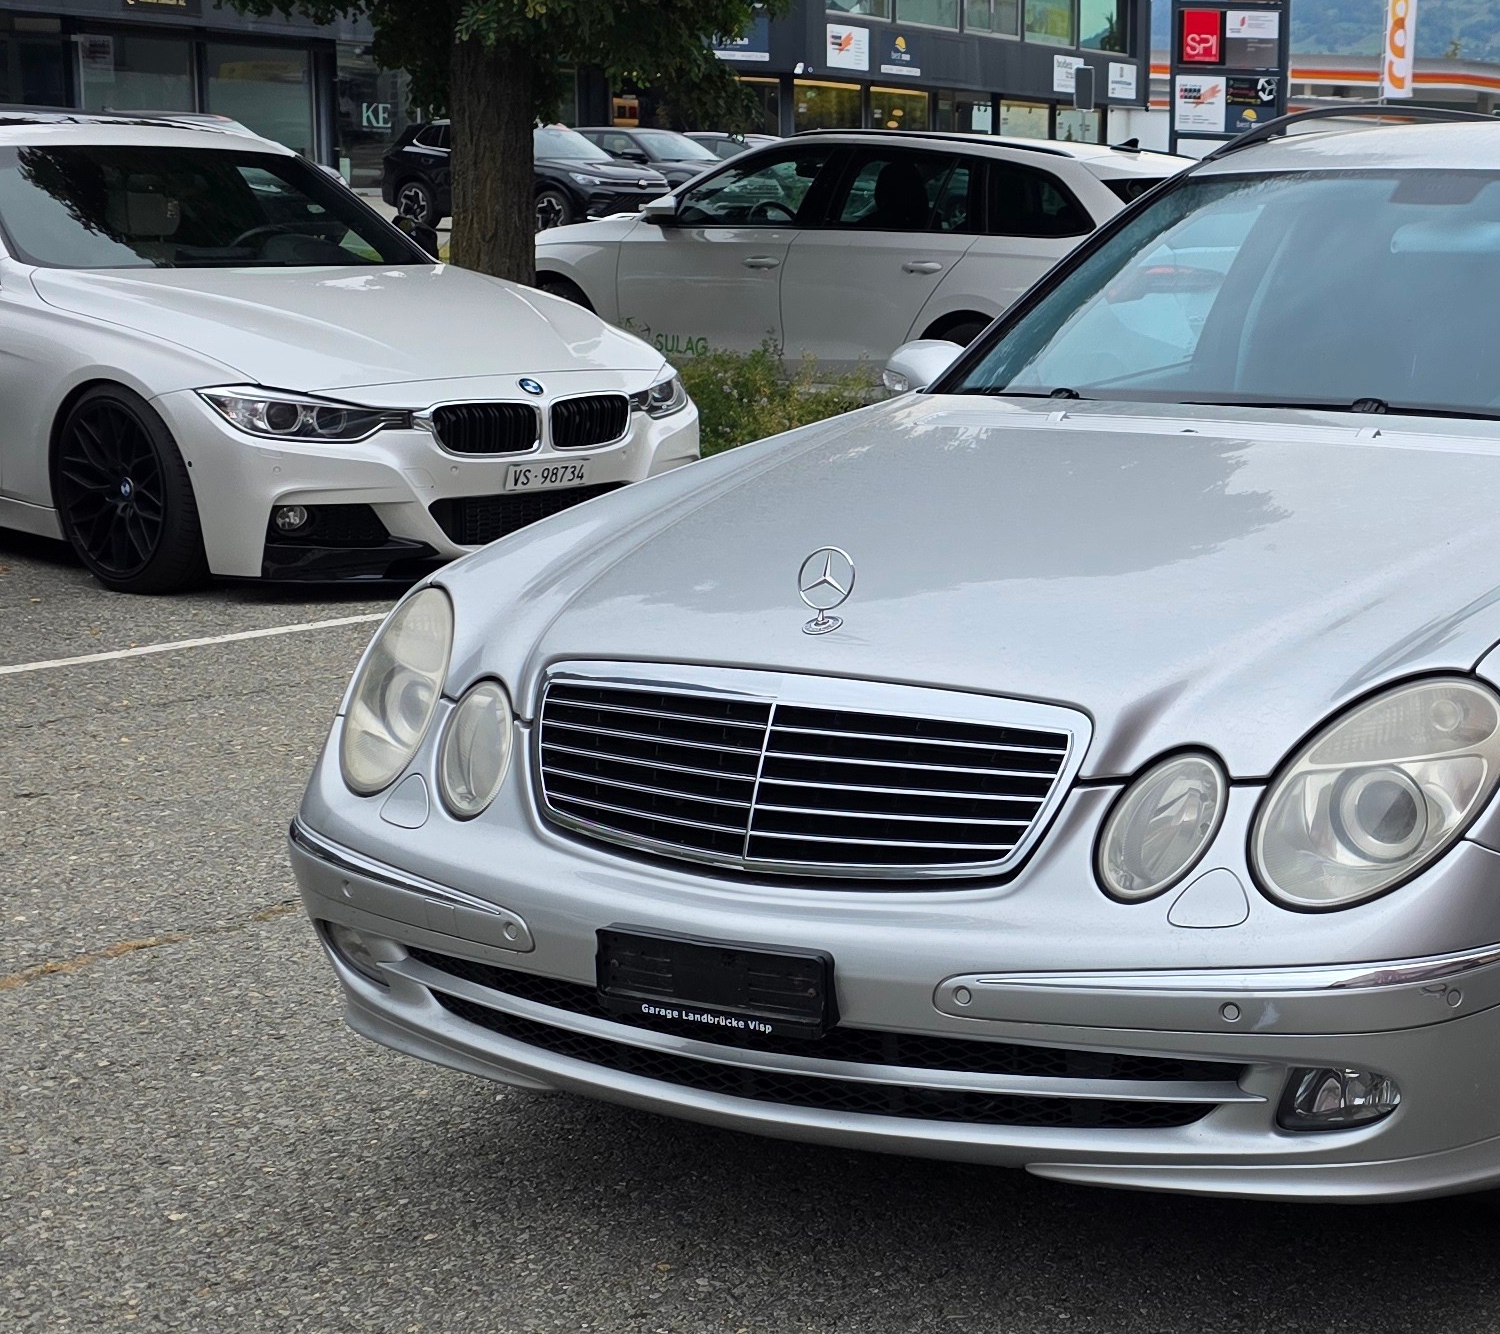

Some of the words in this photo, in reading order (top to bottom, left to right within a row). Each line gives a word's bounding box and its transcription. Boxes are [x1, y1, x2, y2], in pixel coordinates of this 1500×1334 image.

[1186, 33, 1217, 55] SPI
[654, 333, 709, 357] SULAG
[641, 1003, 679, 1019] Garage
[682, 1010, 745, 1028] Landbrücke
[748, 1020, 773, 1034] Visp
